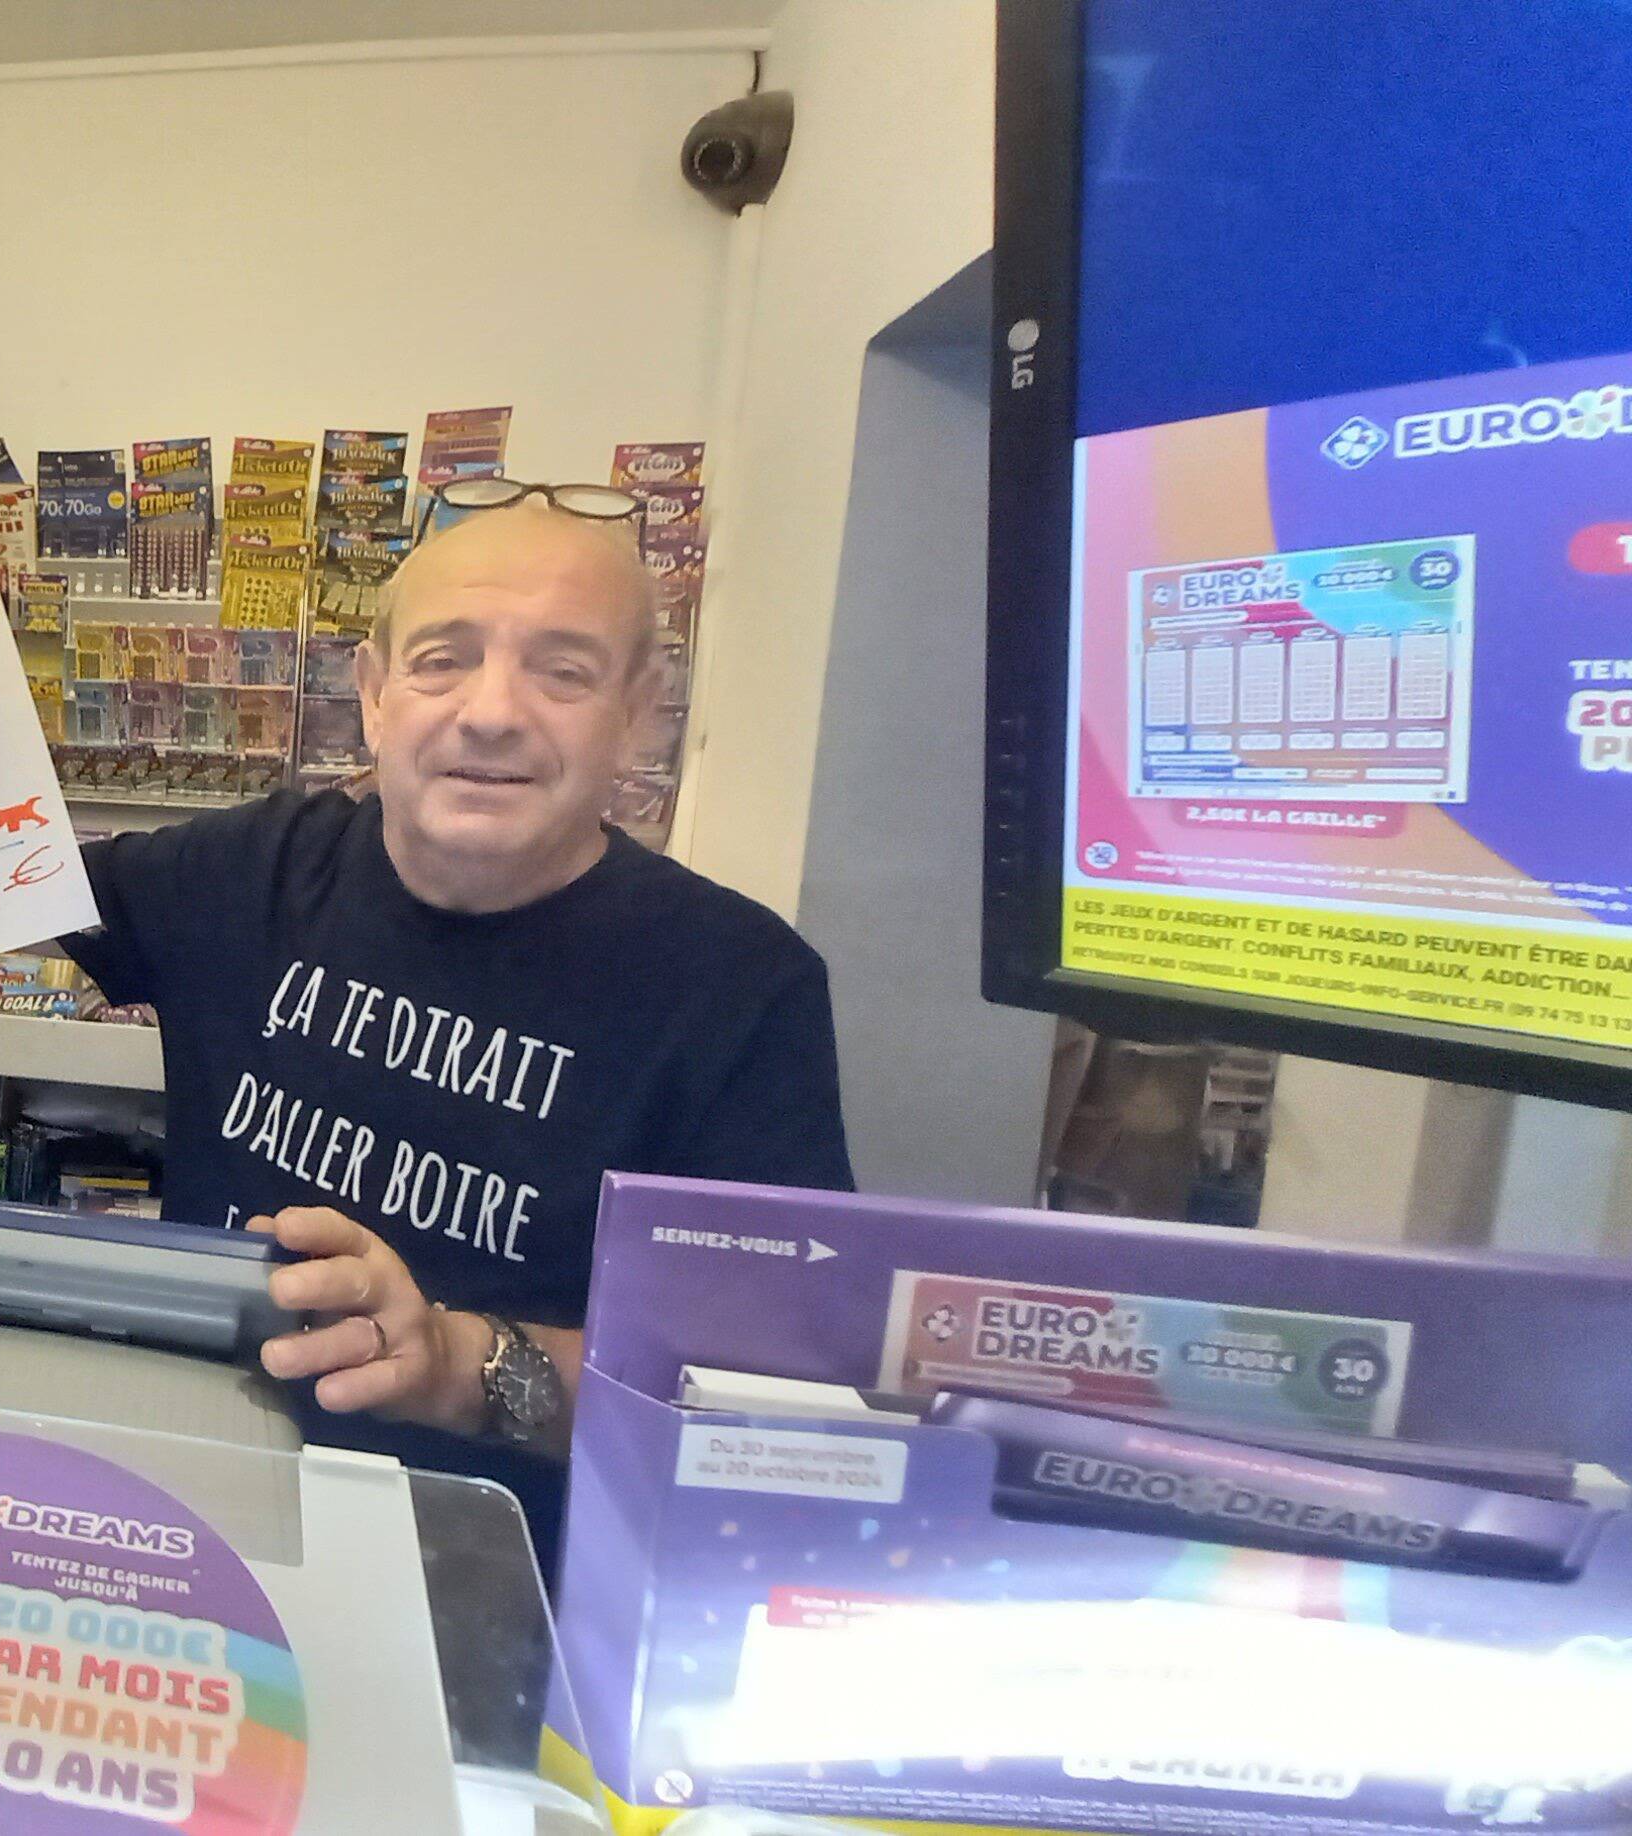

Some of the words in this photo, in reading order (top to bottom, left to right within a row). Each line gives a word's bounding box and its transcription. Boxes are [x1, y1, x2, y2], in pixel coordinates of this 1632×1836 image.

[1011, 352, 1035, 390] LG
[1401, 403, 1562, 451] EURO
[64, 499, 102, 517] 70Go
[1183, 580, 1302, 609] DREAMS
[1184, 569, 1257, 591] EURO
[1592, 736, 1632, 763] P
[1251, 809, 1283, 824] LA
[3, 845, 65, 892] €
[1073, 920, 1141, 941] PERTES
[1242, 939, 1344, 966] CONFLITS
[1074, 899, 1105, 916] LES
[1110, 903, 1154, 920] JEUX
[1157, 907, 1251, 931] D'ARGENT
[1256, 917, 1283, 934] ET
[1286, 921, 1313, 939] DE
[1318, 924, 1408, 947] HASARD
[1414, 933, 1523, 961] PEUVENT
[1528, 943, 1589, 969] ÊTRE
[261, 960, 325, 1038] ÇA
[330, 979, 384, 1059] TE
[384, 996, 576, 1120] DIRAIT
[221, 1072, 376, 1204] D'ALLER
[380, 1140, 540, 1262] BOIRE
[651, 1225, 798, 1257] SERVEZ-VOUS
[982, 1302, 1098, 1338] EURO
[976, 1330, 1160, 1376] DREAMS
[1332, 1357, 1374, 1382] 30
[1039, 1453, 1177, 1502] EURO
[1221, 1487, 1437, 1551] DREAMS
[8, 1504, 191, 1555] DREAMS
[11, 1550, 80, 1576] TENTEZ
[84, 1562, 111, 1580] DE
[113, 1568, 191, 1595] GAGNER
[54, 1575, 139, 1602] JUSQU'À
[67, 1608, 213, 1665] 000€
[77, 1653, 230, 1715] MOIS
[54, 1750, 180, 1810] ANS
